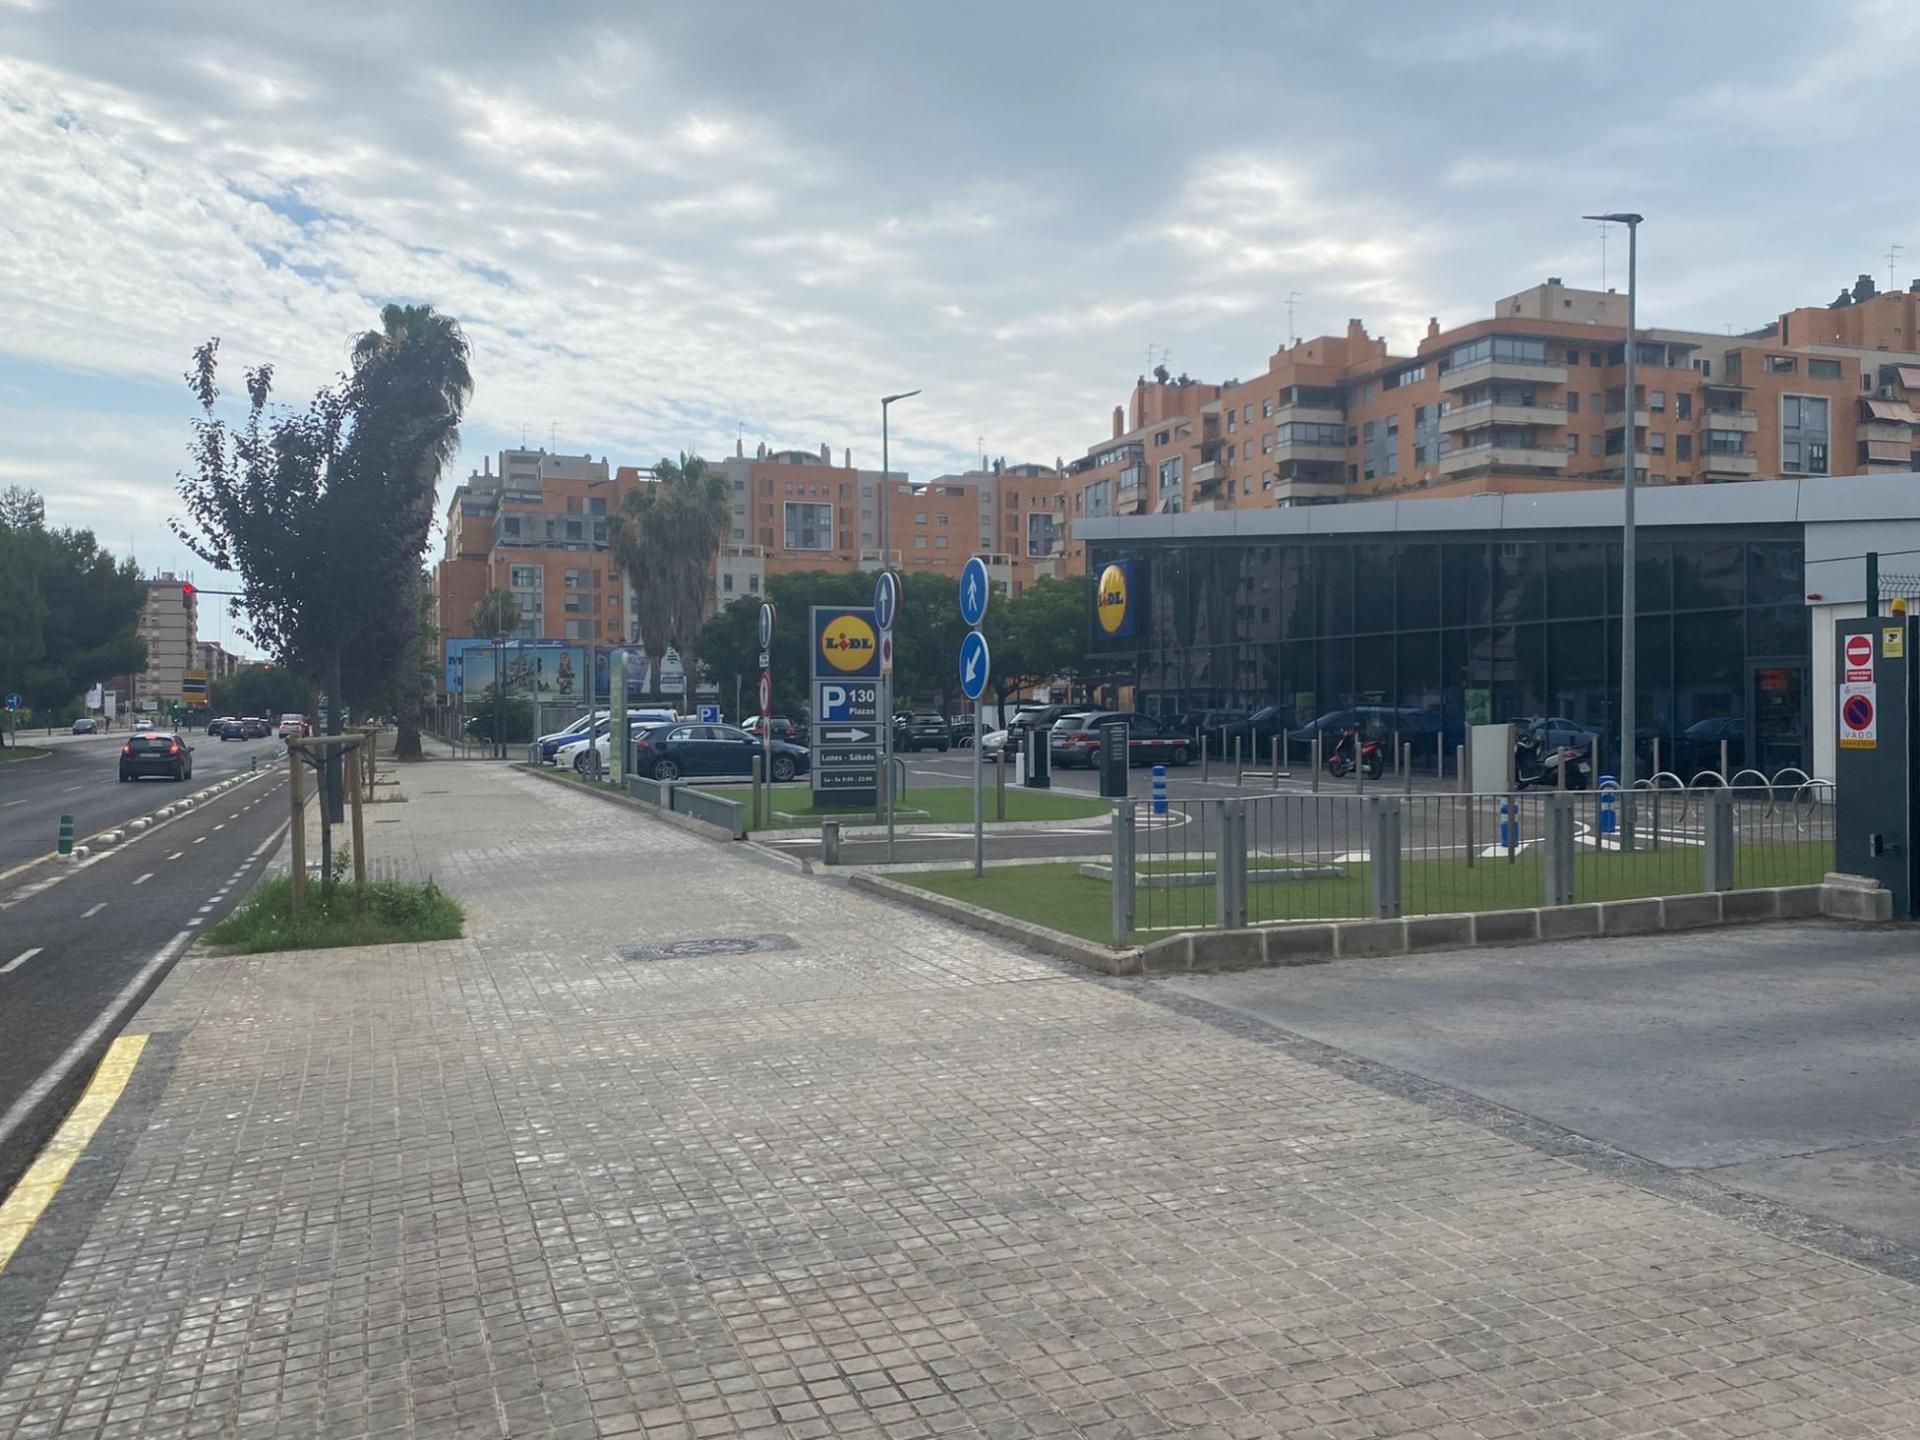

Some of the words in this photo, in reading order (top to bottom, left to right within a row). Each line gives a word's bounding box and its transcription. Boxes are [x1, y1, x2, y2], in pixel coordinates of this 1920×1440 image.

[1099, 589, 1124, 607] LIDL
[825, 633, 872, 651] LIDL
[823, 686, 846, 719] P
[849, 690, 875, 703] 130
[849, 707, 875, 716] Plazas
[701, 708, 711, 722] P
